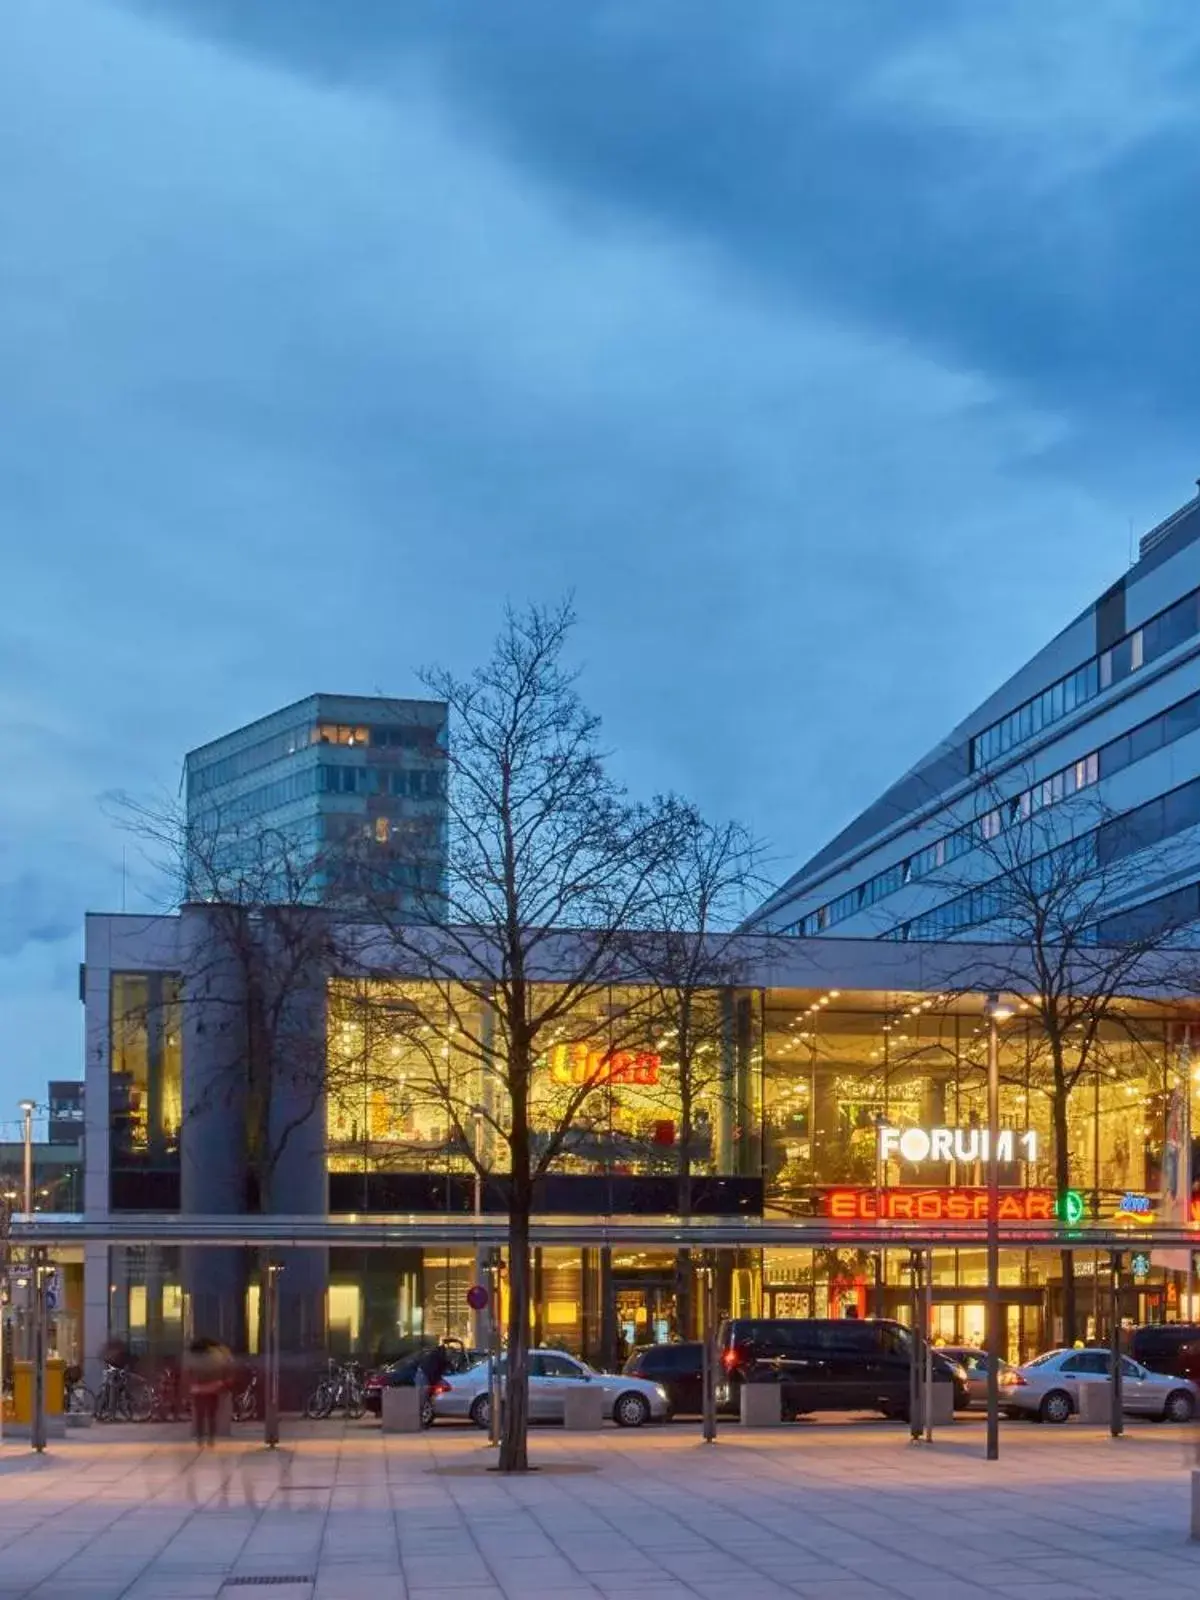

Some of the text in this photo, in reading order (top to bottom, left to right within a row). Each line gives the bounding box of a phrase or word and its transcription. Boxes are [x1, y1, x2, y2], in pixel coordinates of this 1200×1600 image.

[880, 1128, 1038, 1162] FORUM 1
[830, 1193, 1050, 1219] EUROSPAR
